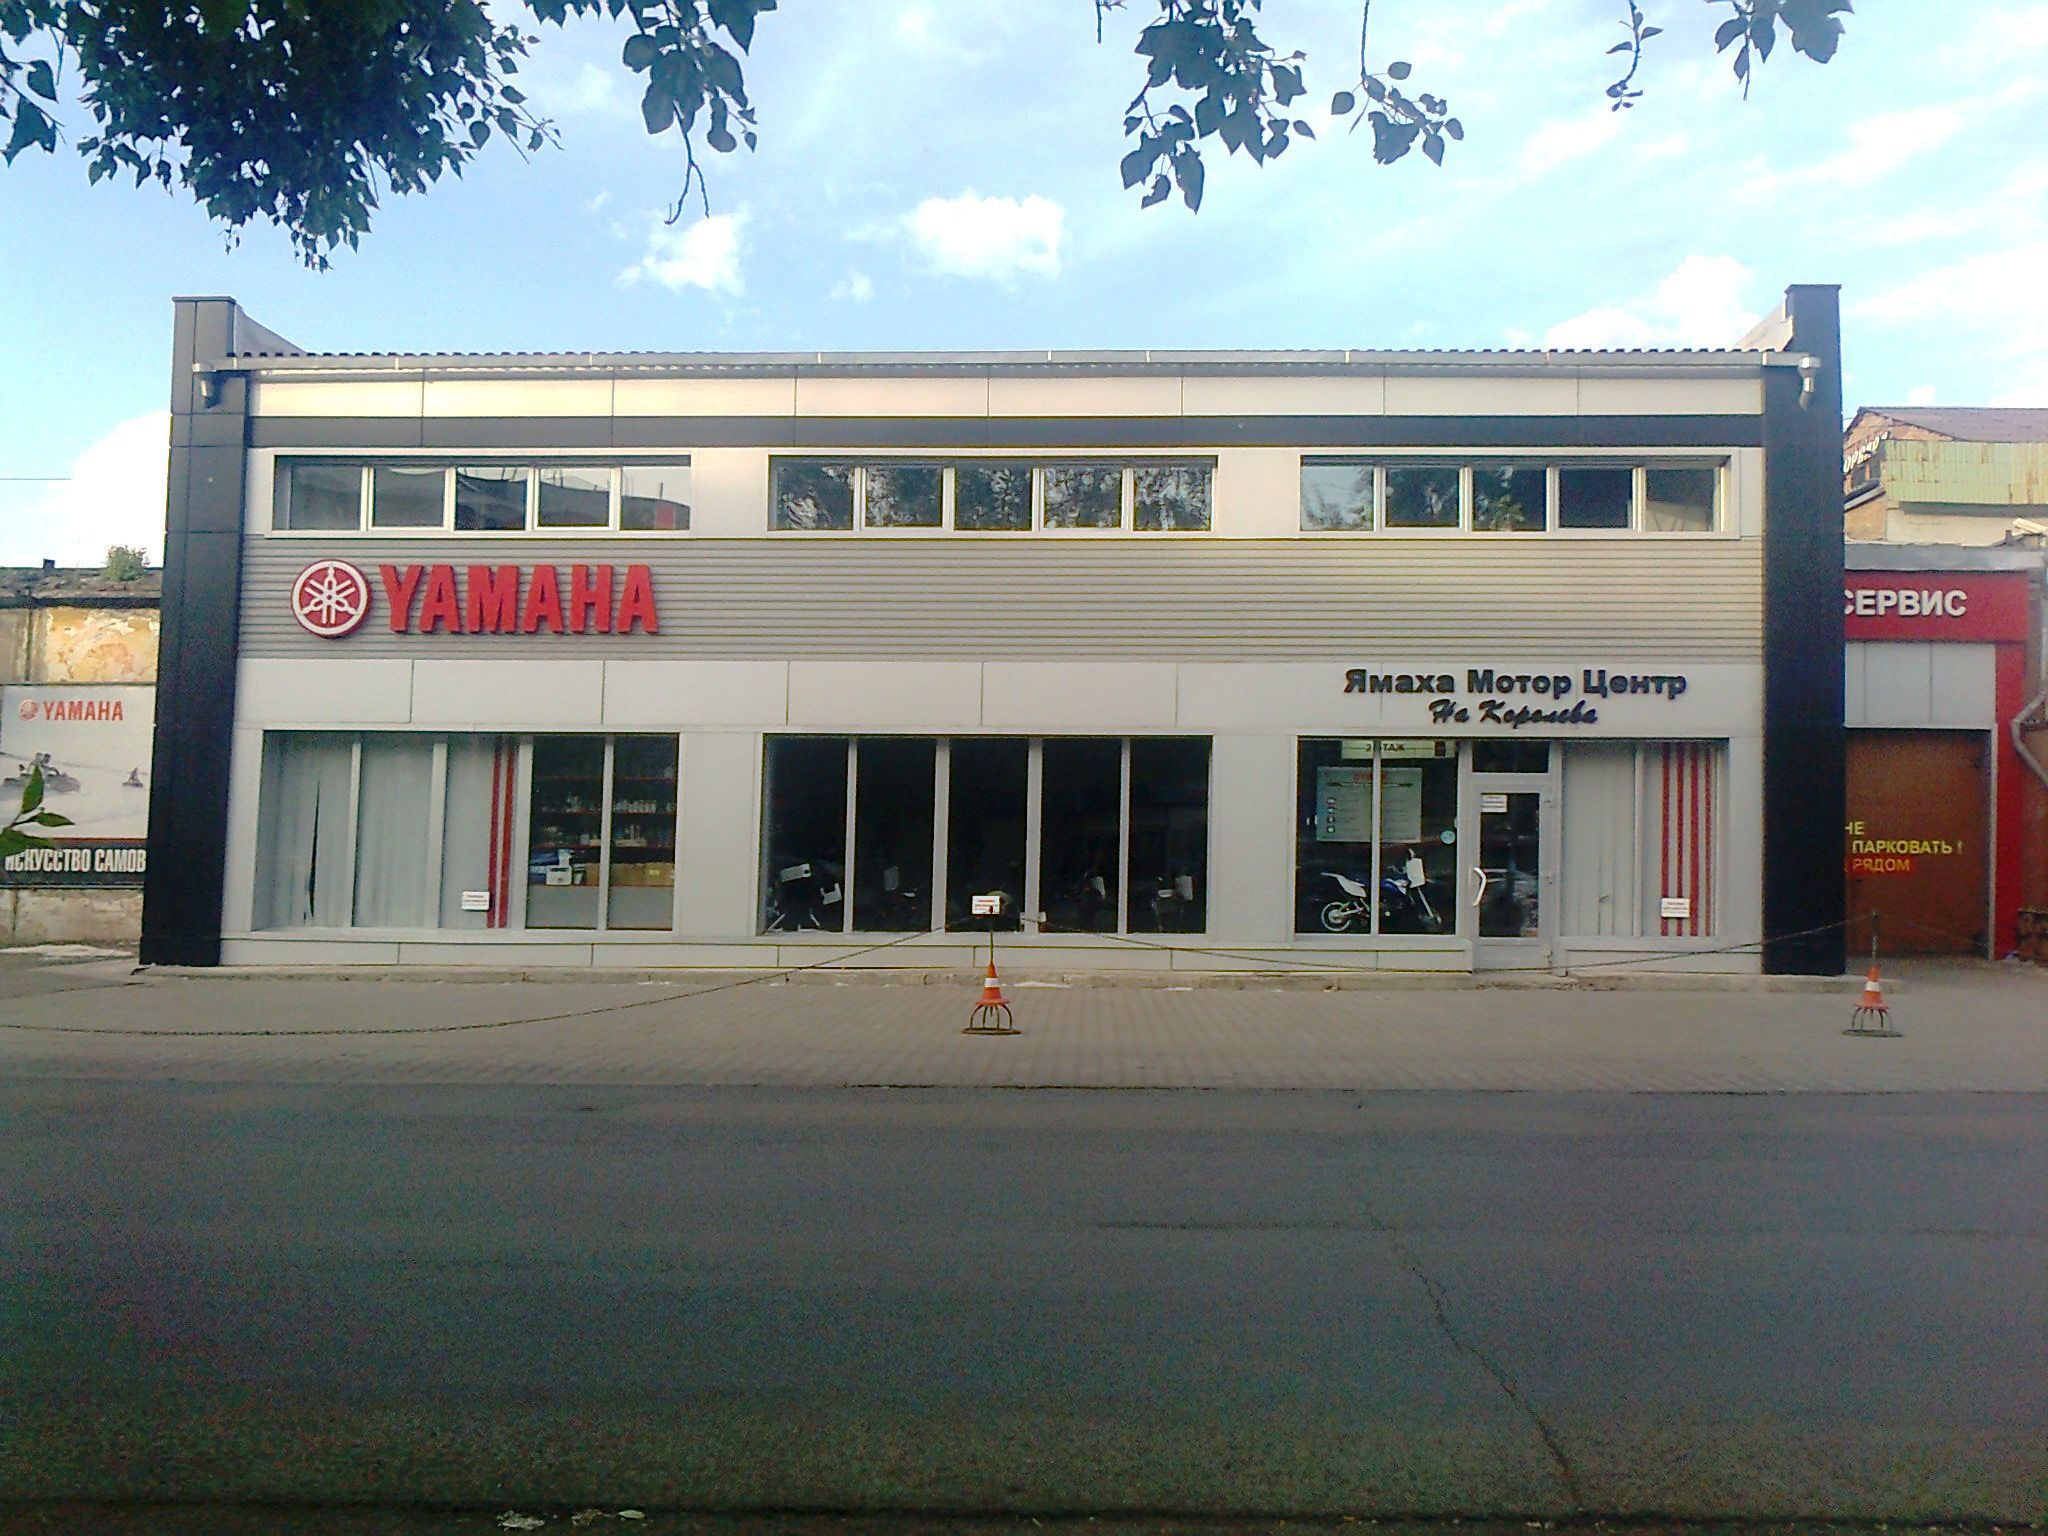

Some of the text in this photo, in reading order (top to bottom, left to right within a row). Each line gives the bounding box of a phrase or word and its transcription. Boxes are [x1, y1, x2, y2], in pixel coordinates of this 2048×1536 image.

[378, 563, 659, 635] YAMAHA
[1343, 668, 1688, 700] Ямаха Мотор Центр
[42, 701, 124, 721] YAMAHA
[1428, 697, 1600, 730] На Королева
[1852, 840, 1953, 854] ПАРКОВАТЬ
[5, 848, 147, 873] ИСКУССТВО САМОВ
[1853, 858, 1911, 873] РЯДОМ
